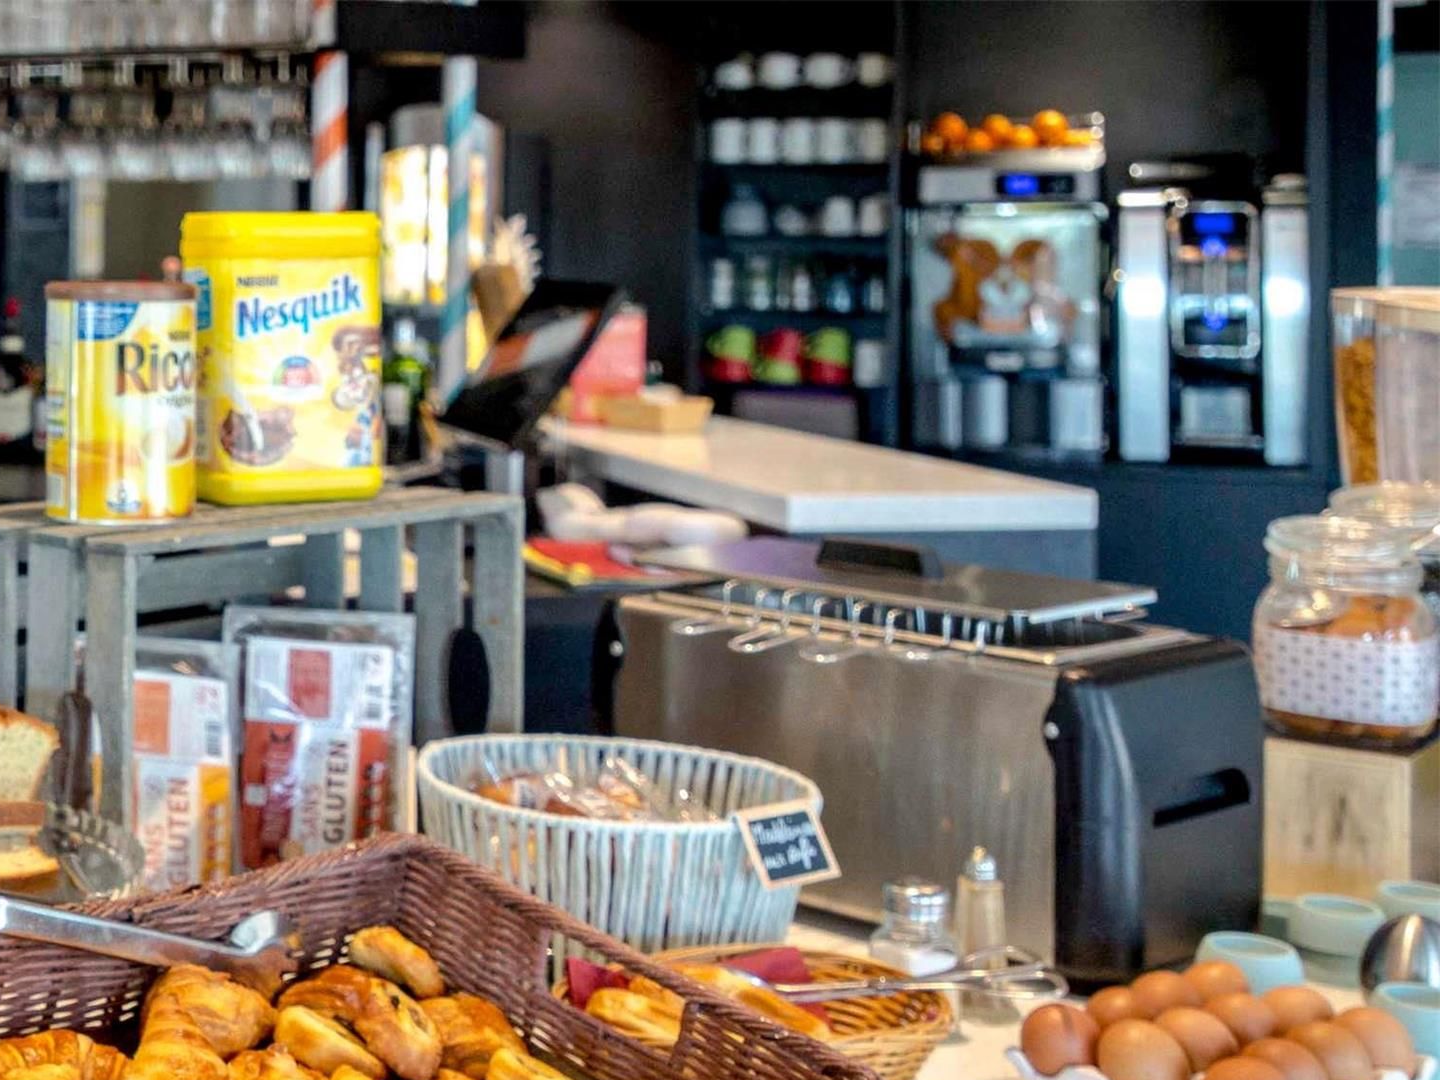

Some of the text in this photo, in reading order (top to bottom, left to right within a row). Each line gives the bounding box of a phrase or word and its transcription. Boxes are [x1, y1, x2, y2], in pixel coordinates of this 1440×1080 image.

[237, 273, 363, 338] Nesquik
[166, 777, 189, 886] GLUTEN
[323, 739, 348, 845] GLUTEN
